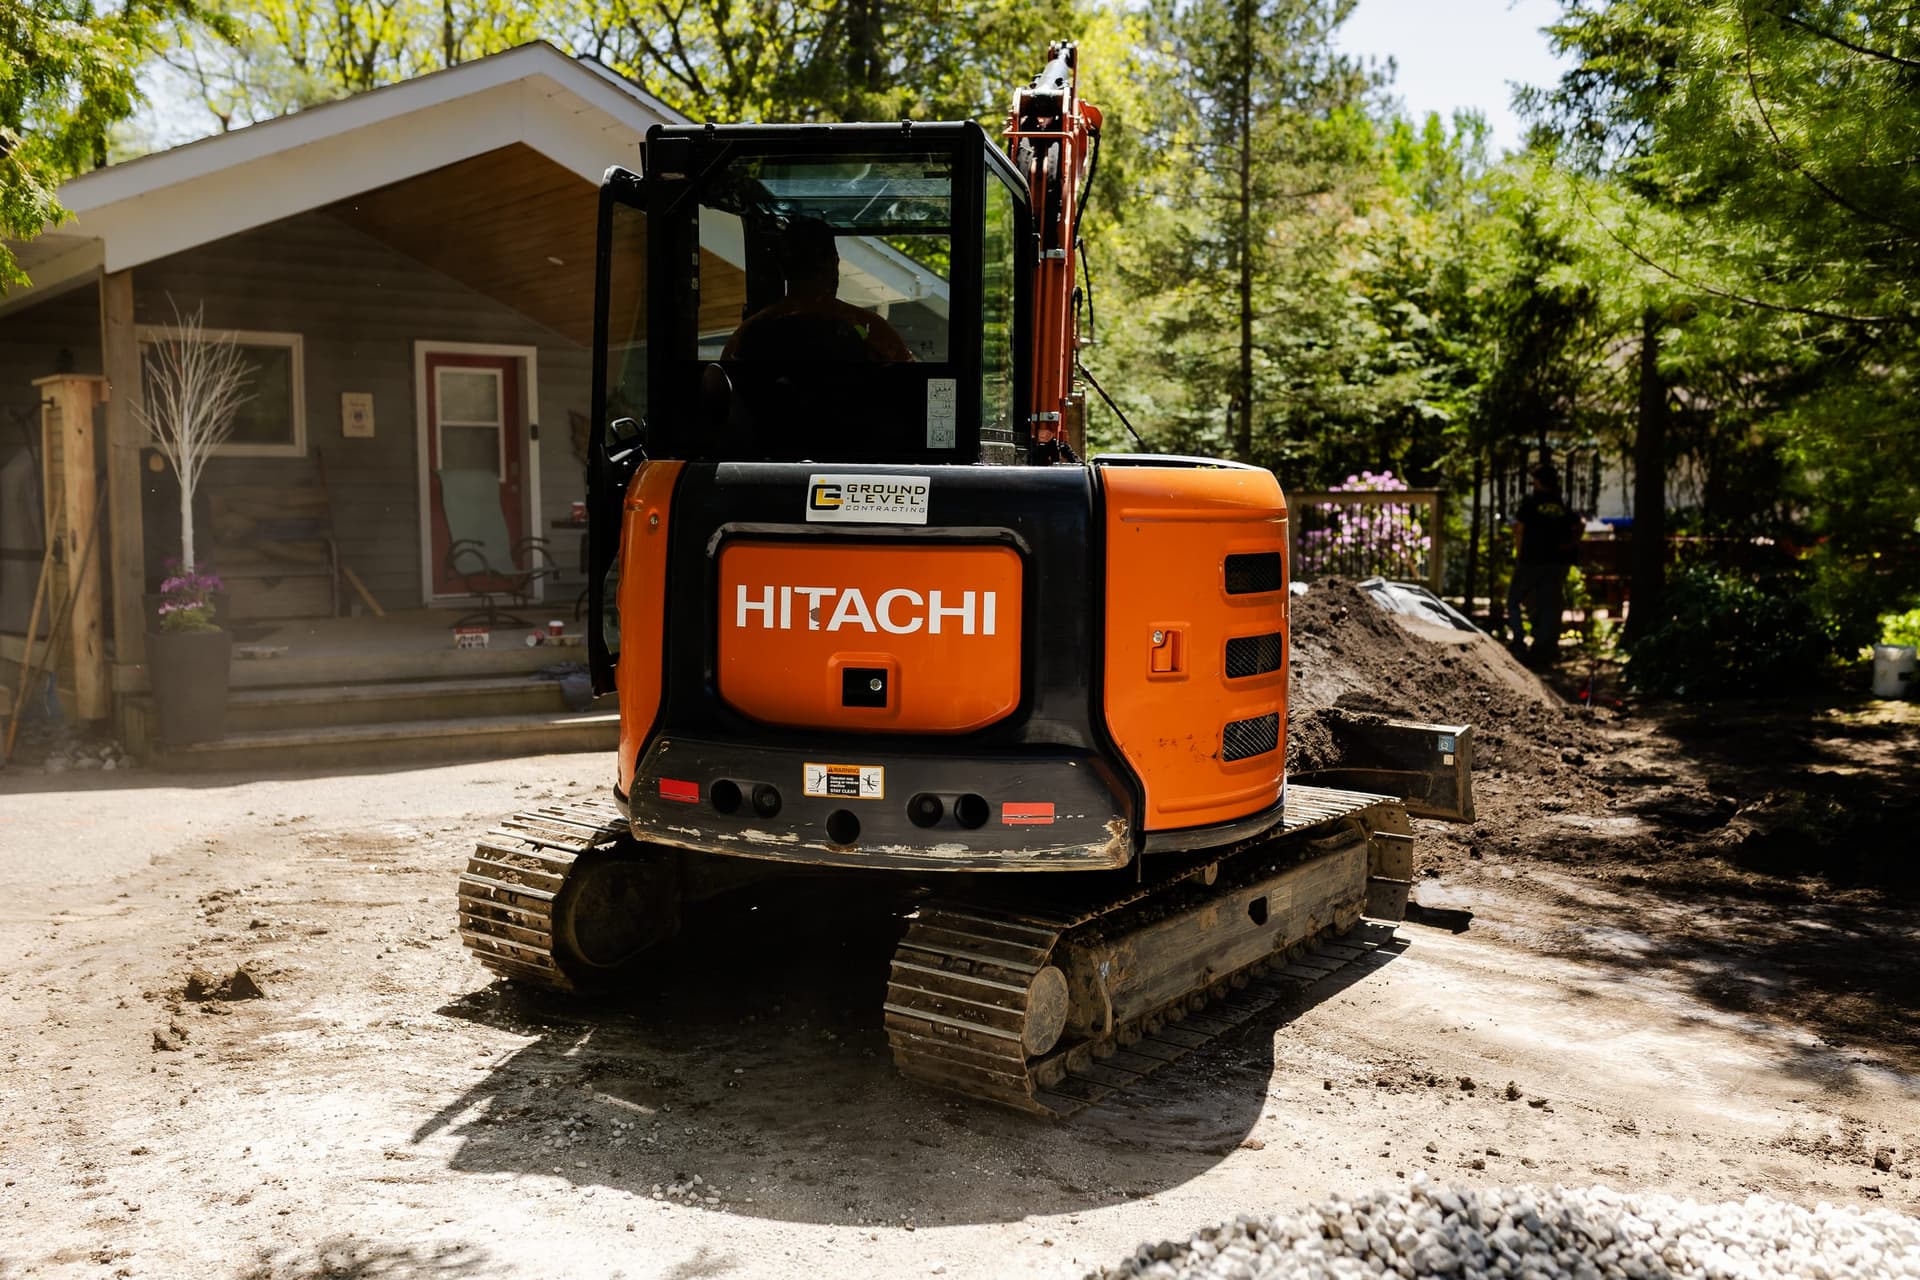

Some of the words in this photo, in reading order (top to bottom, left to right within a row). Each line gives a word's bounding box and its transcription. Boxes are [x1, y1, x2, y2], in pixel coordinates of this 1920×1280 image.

[847, 484, 926, 495] GROUND
[845, 505, 926, 513] CONTRACTING
[736, 584, 996, 636] HITACHI
